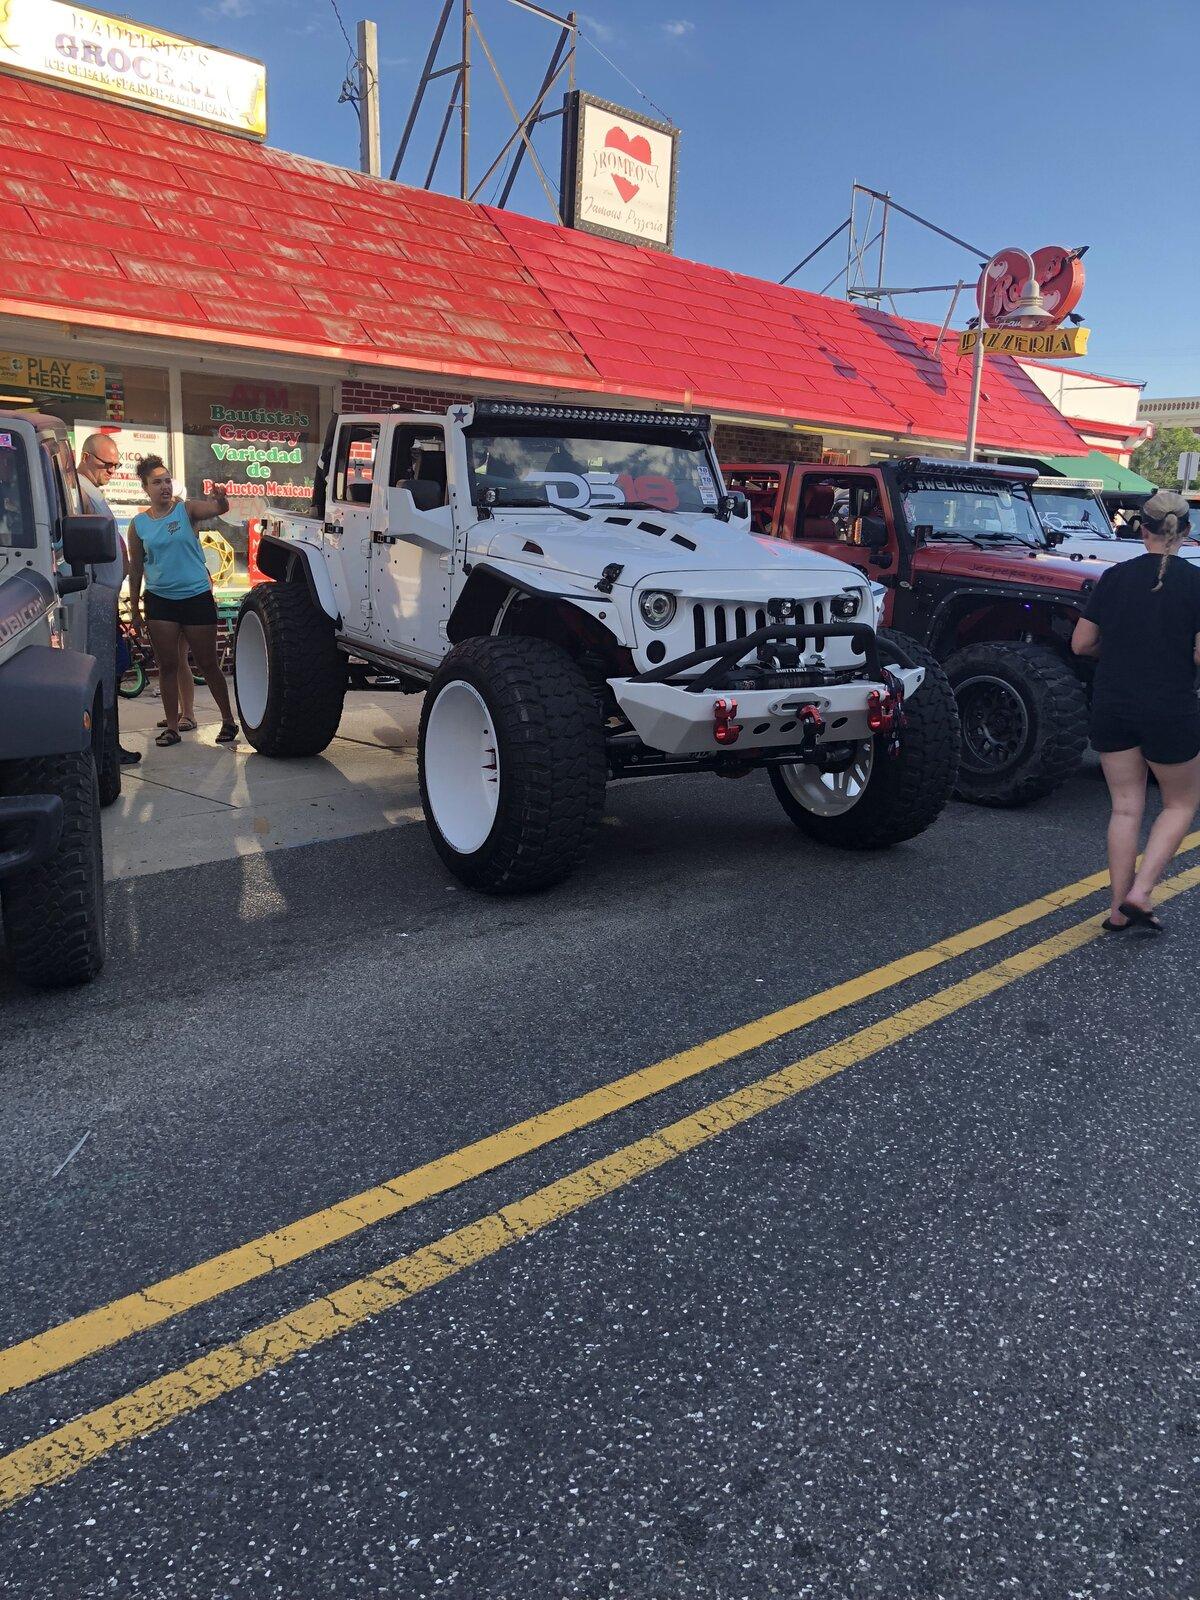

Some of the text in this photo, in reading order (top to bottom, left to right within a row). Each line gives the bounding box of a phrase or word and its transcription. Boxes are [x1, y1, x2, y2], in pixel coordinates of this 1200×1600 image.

[600, 153, 655, 183] ROMEO'S
[962, 332, 1073, 353] PZZERIA
[27, 358, 71, 376] PLAY
[28, 372, 72, 390] HERE
[210, 404, 310, 427] Bautista's
[219, 424, 301, 446] Grocery
[211, 443, 302, 464] Variedad
[246, 461, 271, 478] de
[523, 471, 680, 512] DS18
[0, 597, 45, 643] UBICON
